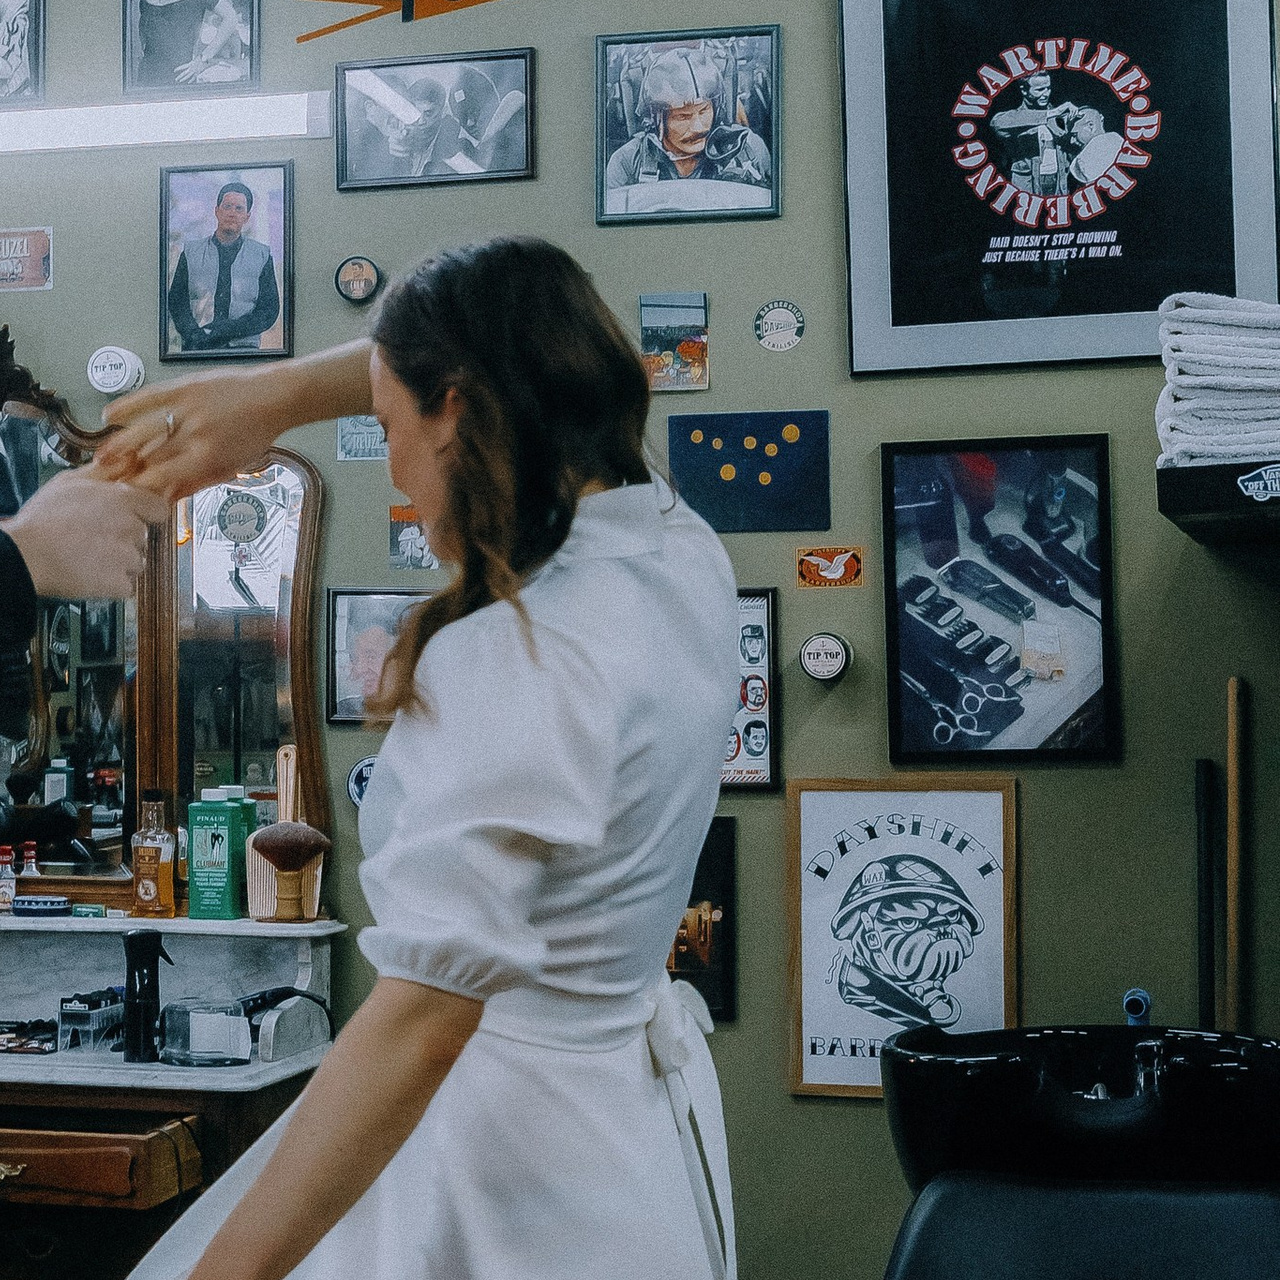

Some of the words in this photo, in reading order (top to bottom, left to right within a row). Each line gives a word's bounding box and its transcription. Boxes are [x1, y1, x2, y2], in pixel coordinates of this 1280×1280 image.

[951, 37, 1152, 118] WARTIME
[951, 110, 1162, 229] BARBERING
[989, 236, 1011, 249] HAIR
[1012, 234, 1050, 248] DOESN'T
[1051, 232, 1075, 246] STOP
[1076, 230, 1118, 245] GROWING
[982, 251, 1003, 263] JUST
[1005, 249, 1041, 262] BECAUSE
[1043, 247, 1078, 261] THERE'S
[1079, 247, 1085, 258] A
[1088, 246, 1107, 258] WAR
[94, 365, 107, 373] TIP
[109, 362, 124, 371] TOP
[1266, 479, 1280, 491] TH
[806, 651, 822, 661] TIP
[823, 651, 841, 660] TOP
[804, 813, 1005, 882] DAYSHIFT
[809, 1036, 884, 1058] BARB
